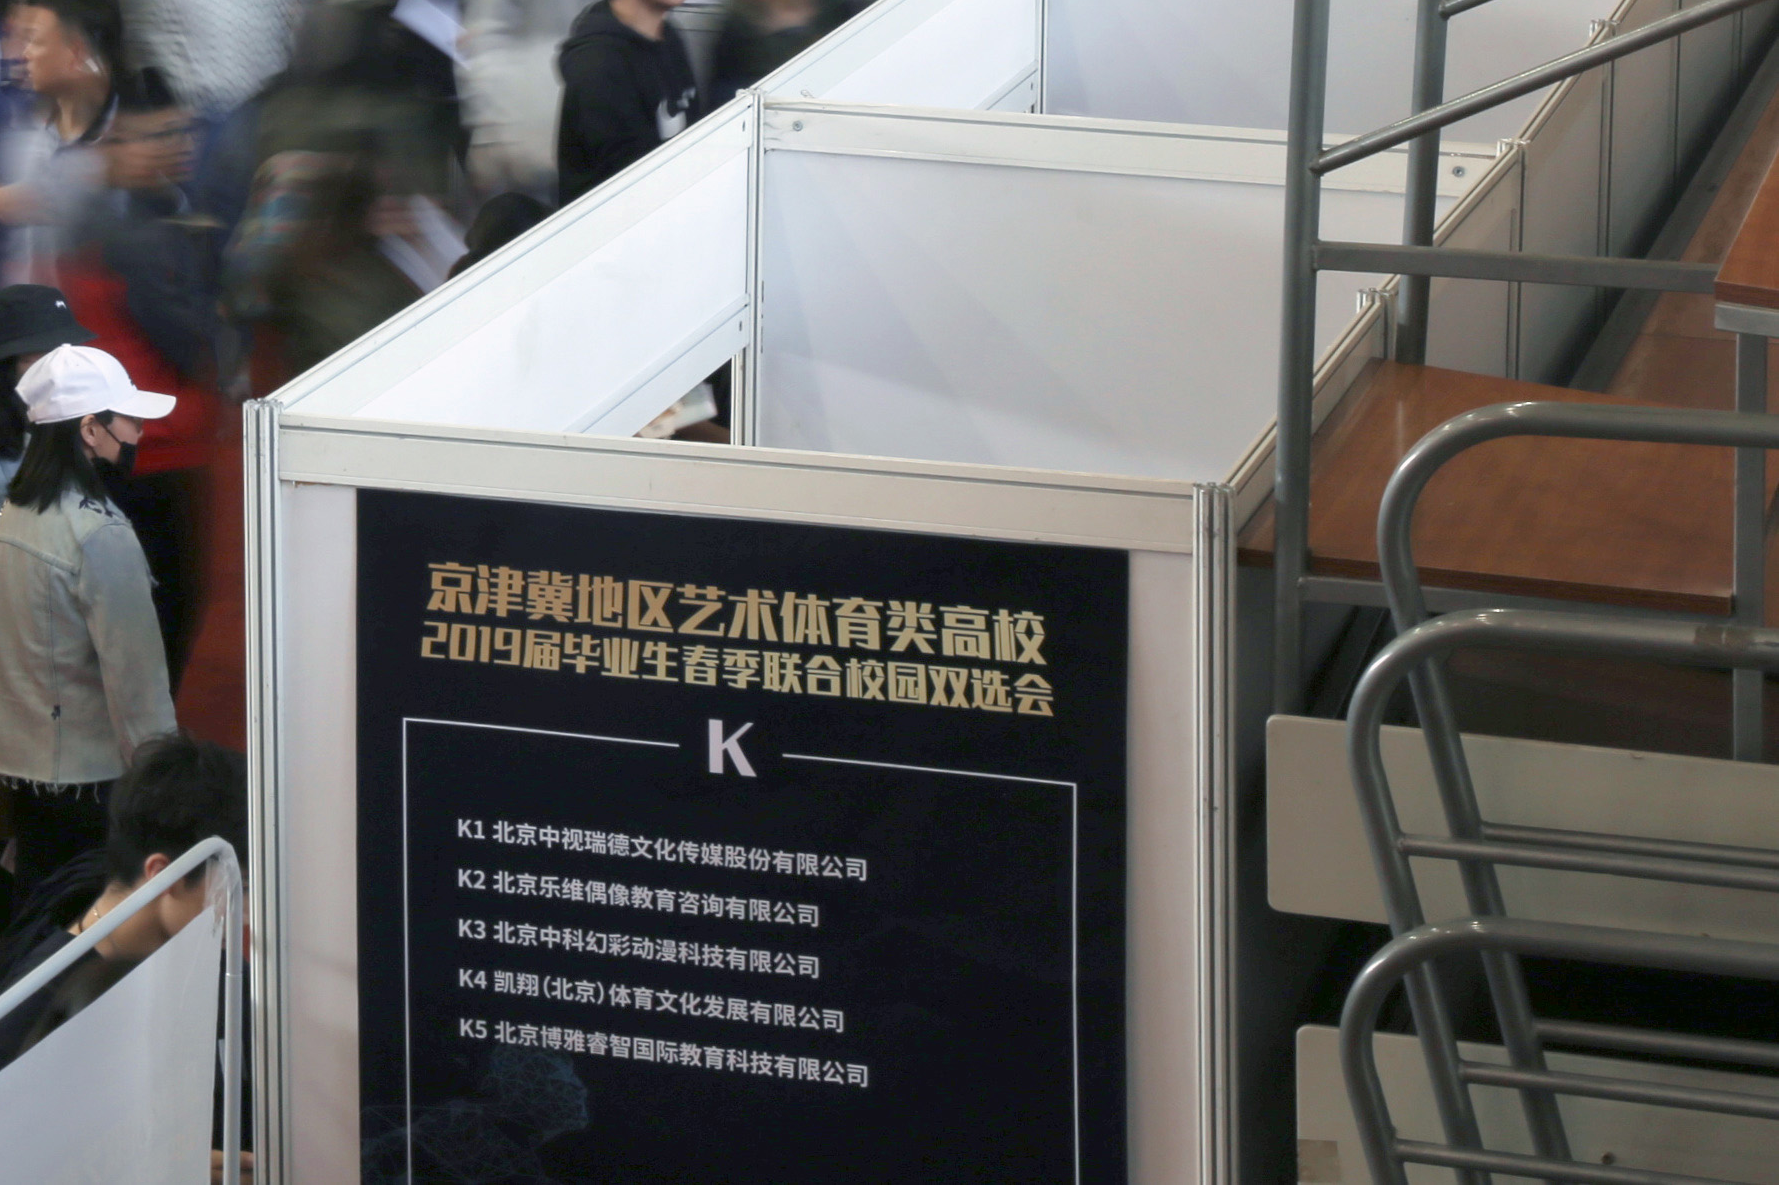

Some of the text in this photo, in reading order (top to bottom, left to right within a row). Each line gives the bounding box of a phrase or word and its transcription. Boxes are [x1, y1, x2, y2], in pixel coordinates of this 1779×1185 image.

[426, 561, 1048, 667] 京津冀地区艺术体育类高校
[420, 620, 1056, 718] 2019届毕业生春季联合校园双选会
[708, 718, 757, 778] K
[457, 818, 869, 882] K1 北京中视瑞德文化传媒股份有限公司
[458, 868, 821, 929] K2 北京乐维偶像教育咨询有限公司
[458, 918, 821, 980] K3 北京中科幻彩动漫科技有限公司
[459, 968, 845, 1034] K4 凯翔(北京)体育文化发展有限公司
[459, 1018, 870, 1089] K5 北京博雅睿智国际教育科技有限公司
